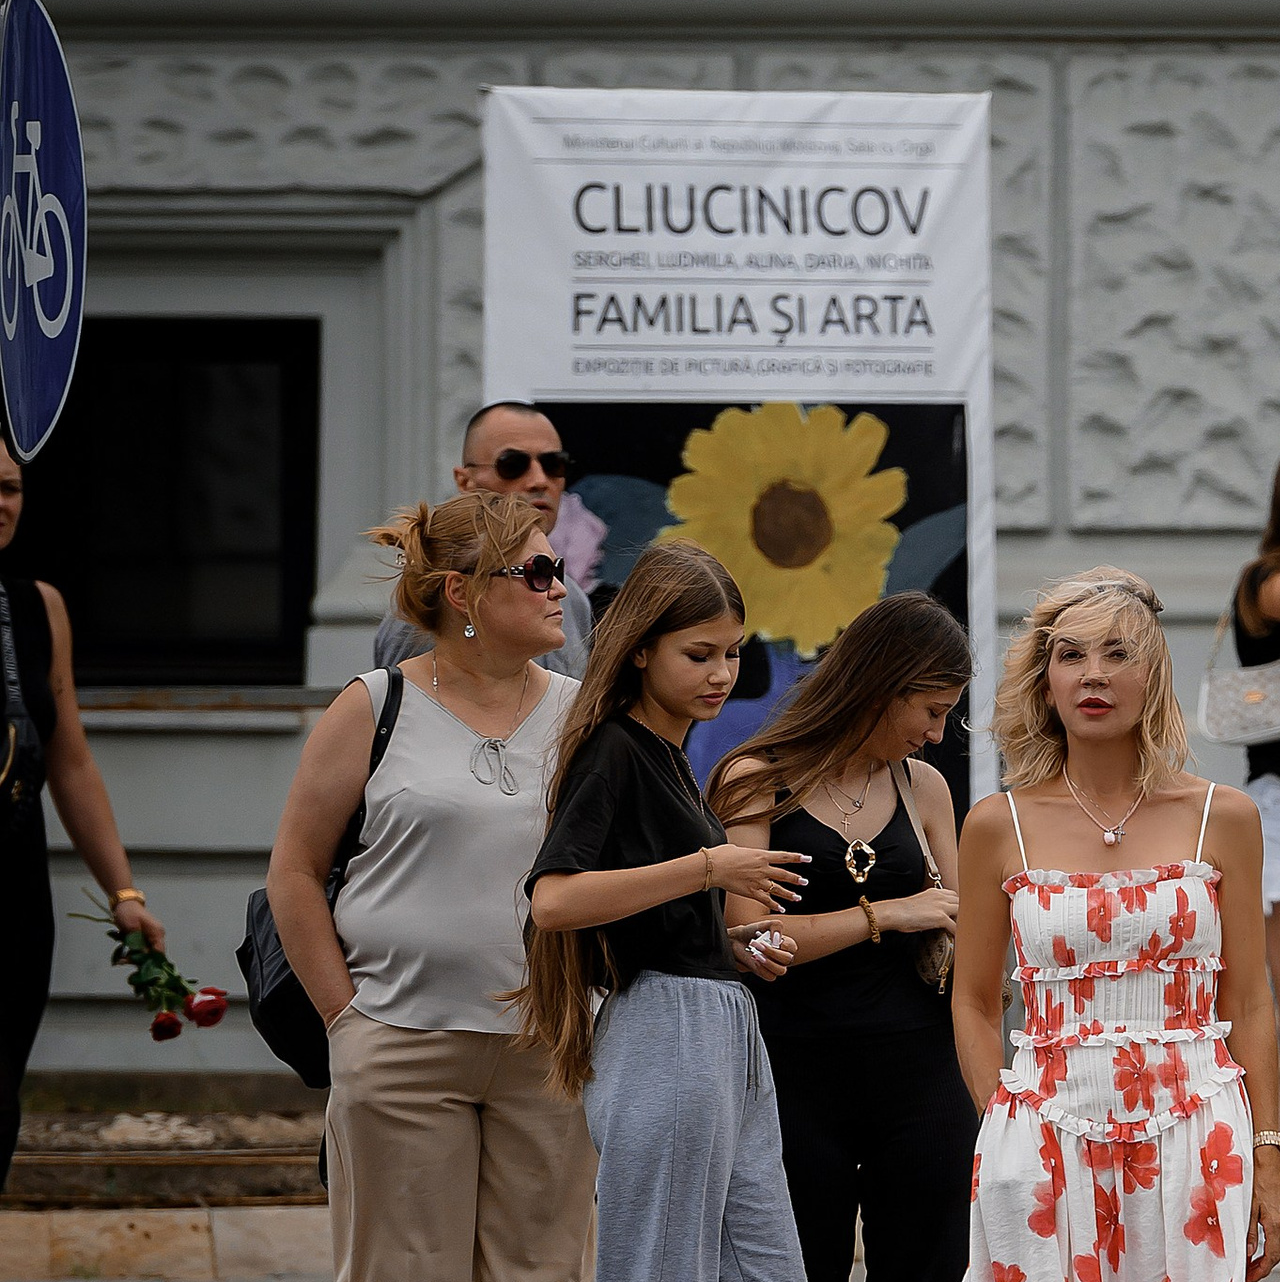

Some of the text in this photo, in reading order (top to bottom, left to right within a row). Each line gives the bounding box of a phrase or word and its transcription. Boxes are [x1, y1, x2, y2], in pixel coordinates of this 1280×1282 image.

[573, 181, 930, 236] CLIUCINICOV
[572, 293, 758, 335] FAMILIA
[820, 295, 934, 336] ARTA
